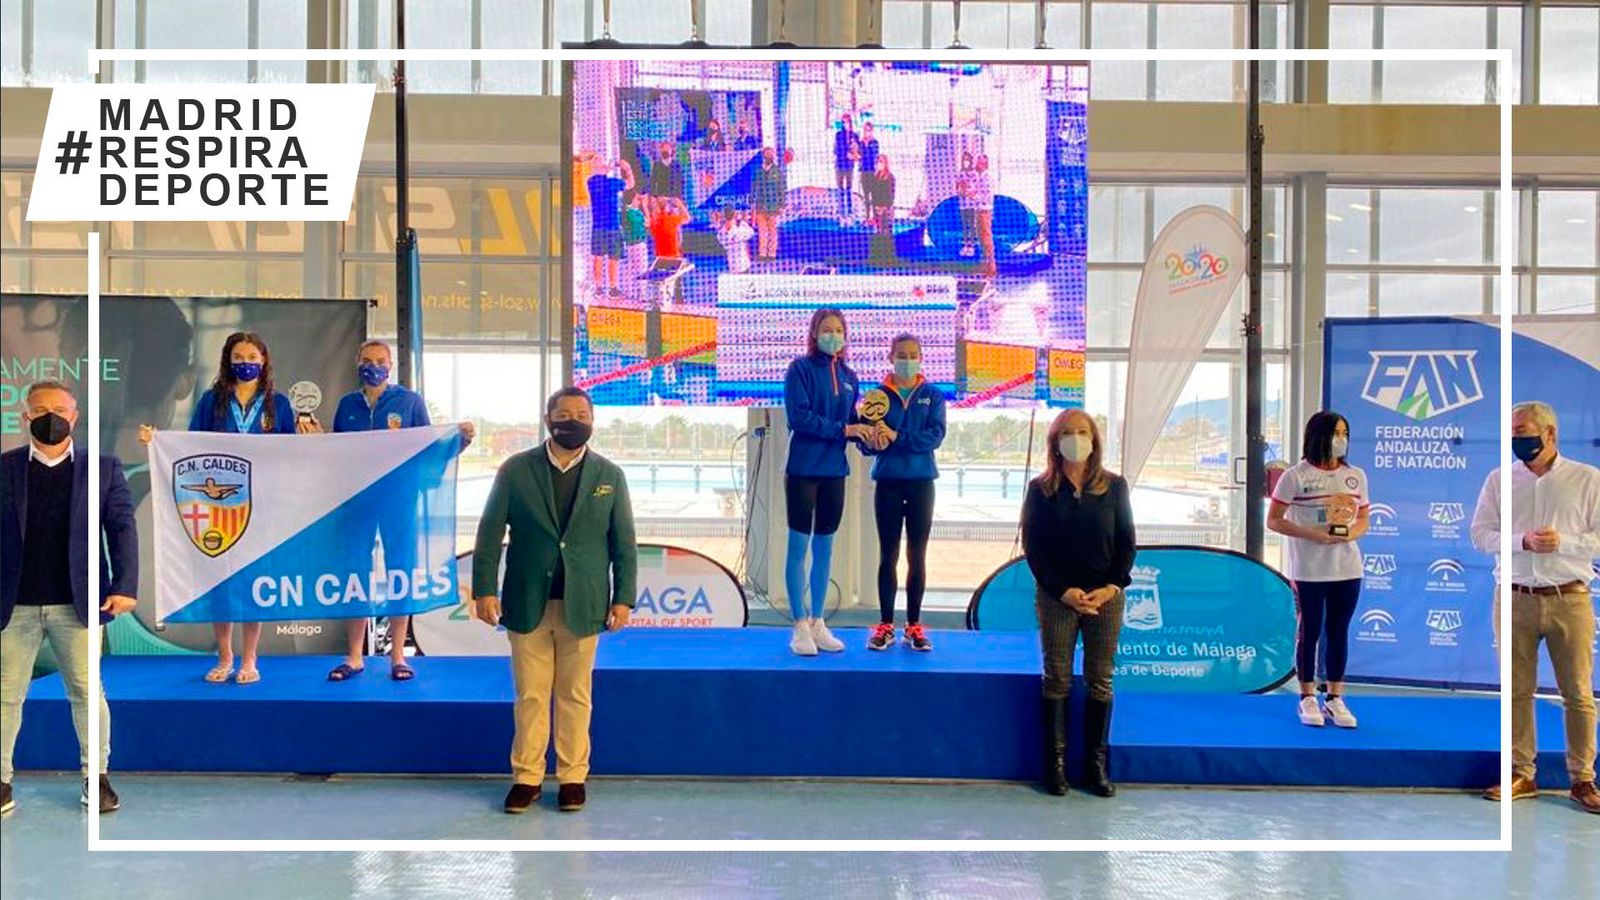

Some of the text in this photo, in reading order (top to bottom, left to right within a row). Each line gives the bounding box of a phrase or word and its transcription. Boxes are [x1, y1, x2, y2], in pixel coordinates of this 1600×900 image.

[1361, 350, 1484, 421] FAN
[1375, 424, 1465, 439] FEDERACIÓN
[1374, 441, 1451, 454] ANDALUZA
[203, 457, 247, 475] CALDES
[1375, 453, 1467, 469] DE NATACIÓN
[1428, 502, 1465, 524] FAN
[1362, 554, 1397, 576] FAN
[251, 565, 452, 608] CN CALDES
[680, 618, 713, 627] SPORT
[1425, 609, 1462, 632] FAN
[275, 623, 322, 637] Málaga
[1166, 641, 1188, 656] de
[1193, 640, 1257, 661] Málaga
[1131, 665, 1148, 676] de
[1152, 665, 1204, 678] Deporte
